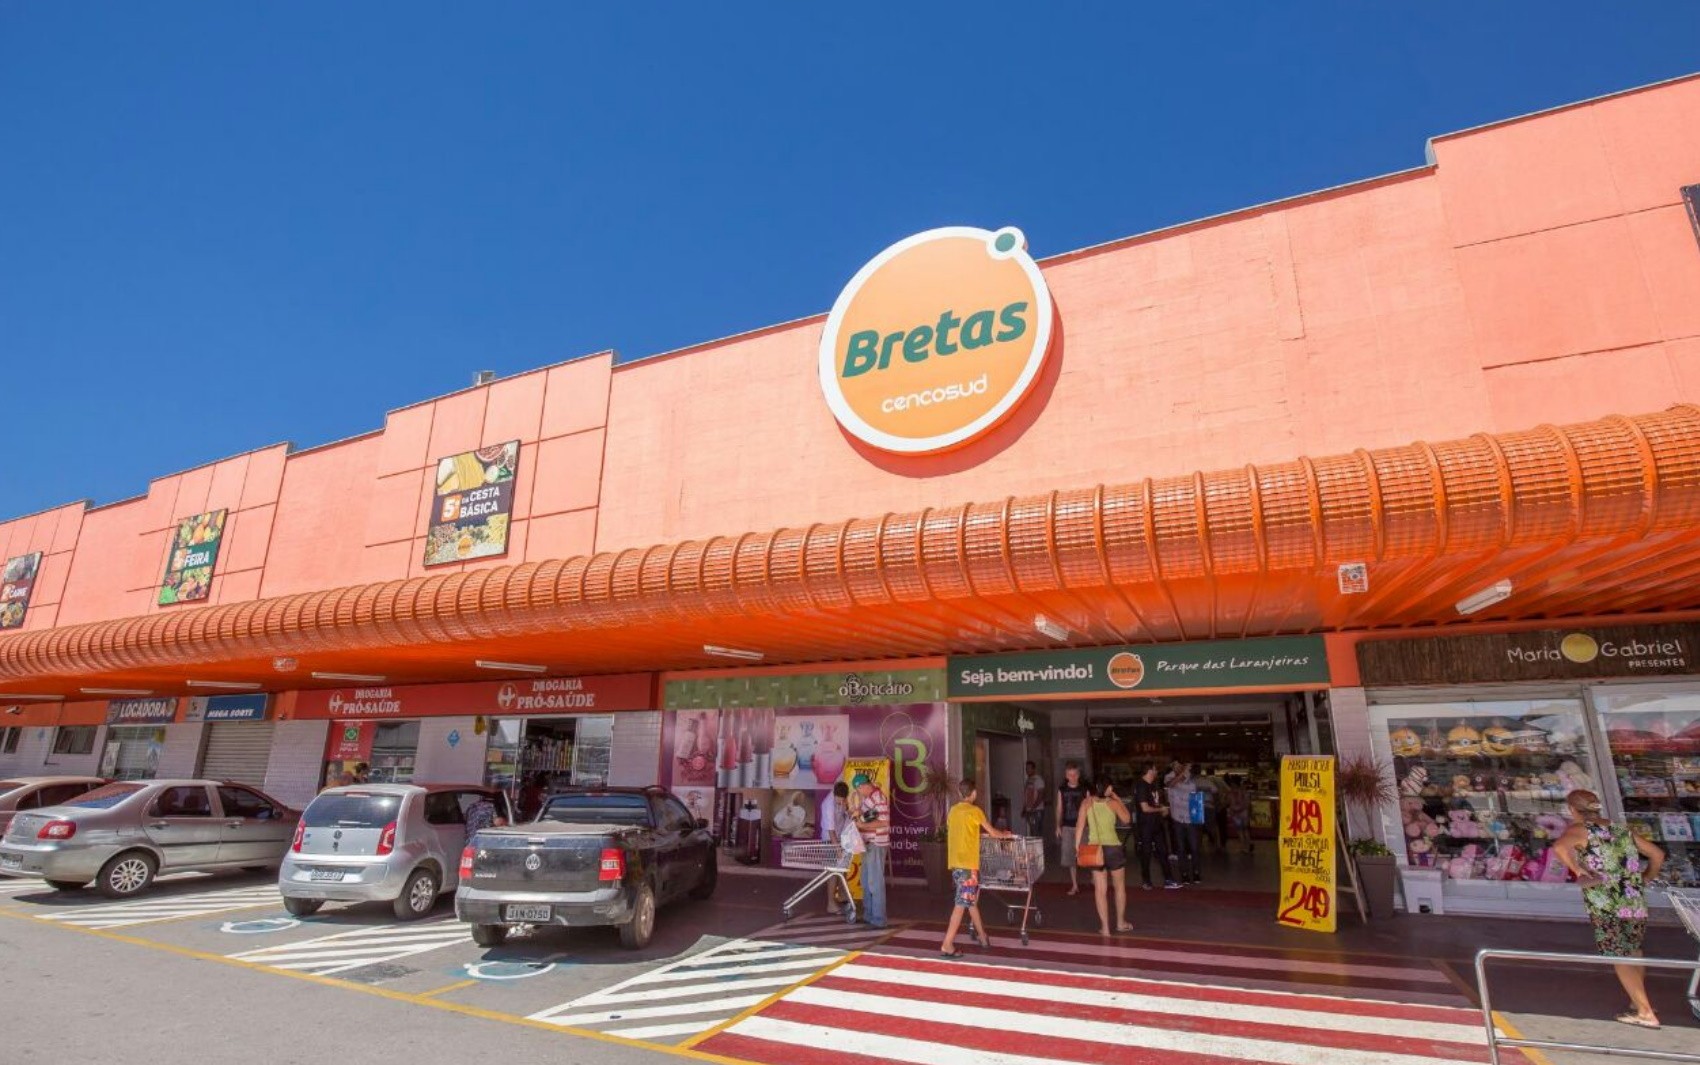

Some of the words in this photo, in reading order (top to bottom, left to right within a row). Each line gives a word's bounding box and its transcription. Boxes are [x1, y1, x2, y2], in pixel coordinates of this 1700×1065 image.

[842, 302, 1028, 378] Bretas
[881, 373, 988, 413] cencosud
[469, 487, 500, 501] CESTA
[460, 501, 498, 518] BÁSICA
[184, 550, 210, 567] FEIRA
[1507, 646, 1561, 663] Maria
[1601, 639, 1682, 657] Gabriel
[1156, 659, 1199, 673] Parque
[1202, 658, 1227, 670] das
[1230, 655, 1309, 671] Laranjeiras
[1628, 658, 1686, 668] PRESENTES
[961, 670, 994, 687] Seja
[997, 664, 1093, 683] bem-vindo!
[355, 688, 392, 699] DROGARIA
[532, 678, 583, 692] DROGARIA
[342, 699, 401, 714] PRÓ-SAÚDE
[516, 691, 595, 709] PRÓ-SAÚDE
[120, 700, 166, 718] LOCADORA
[231, 708, 254, 718] SORTE
[904, 822, 930, 835] viver
